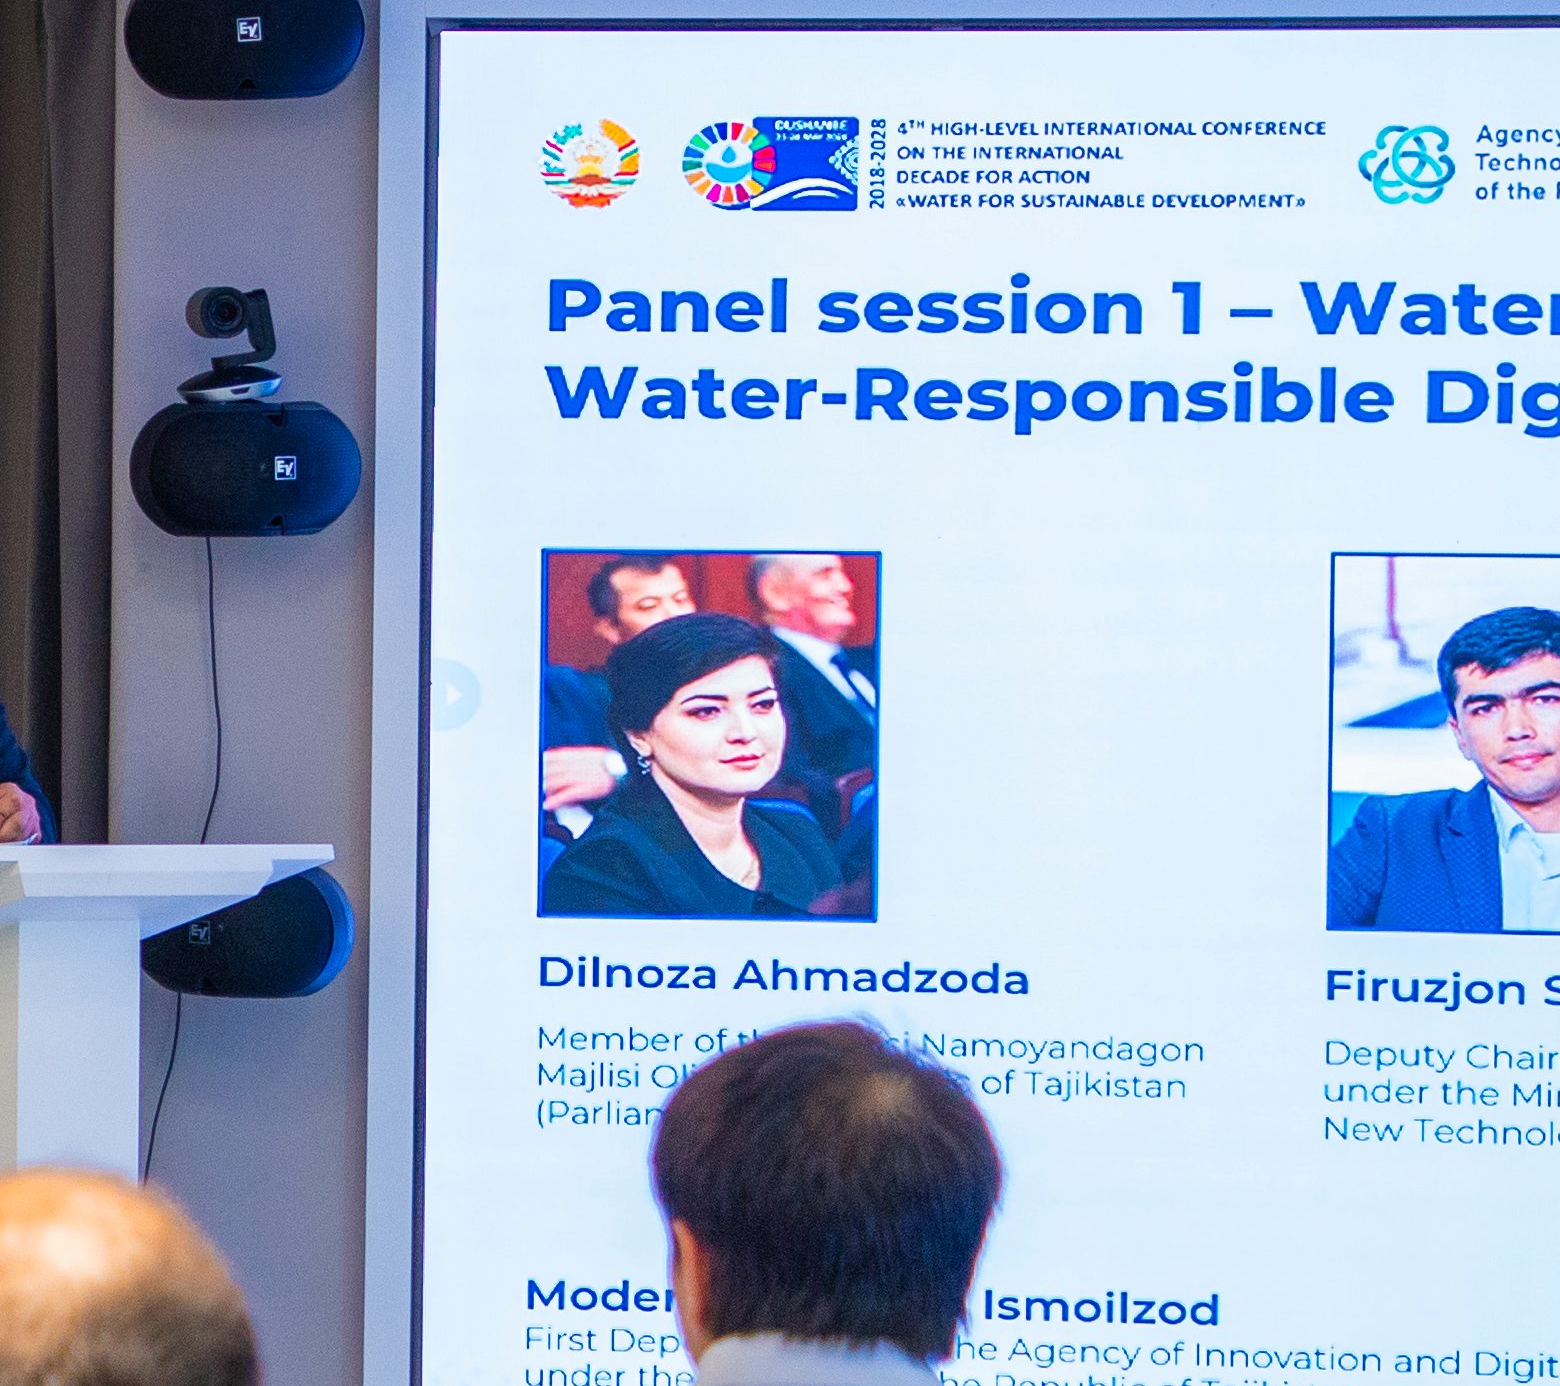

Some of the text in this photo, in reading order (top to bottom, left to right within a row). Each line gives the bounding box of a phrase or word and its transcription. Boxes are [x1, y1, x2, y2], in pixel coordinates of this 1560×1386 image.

[897, 119, 1326, 136] 4TH HIGH-LEVEL INTERNATIONAL CONFERENCE
[870, 118, 886, 208] 2018-2028
[897, 146, 1124, 161] ON THE INTERNATIONAL
[896, 170, 1090, 185] DECADE FOR ACTION
[1475, 181, 1499, 200] of
[1507, 182, 1546, 200] the
[896, 194, 1305, 208] «WATER FOR SUSTAINABLE DEVELOPMENT»
[549, 278, 788, 333] Panel
[818, 272, 1142, 334] session
[1172, 281, 1201, 335] 1
[544, 361, 1394, 435] Water-Responsible
[540, 956, 1029, 994] Dilnoza Ahmadzoda
[1327, 969, 1525, 1012] Firuzjon
[539, 1026, 683, 1052] Member
[695, 1027, 728, 1053] of
[923, 1032, 1205, 1066] Namoyandagon
[1326, 1040, 1455, 1073] Deputy
[538, 1062, 639, 1093] Majlisi
[981, 1069, 1015, 1094] of
[1025, 1071, 1185, 1102] Tajikistan
[1324, 1079, 1429, 1104] under
[1441, 1080, 1499, 1106] the
[1325, 1116, 1404, 1142] New
[527, 1279, 1219, 1326] Moder Ismoilzod
[526, 1326, 596, 1351] First
[611, 1328, 680, 1359] Dep
[956, 1333, 997, 1361] he
[1008, 1338, 1141, 1371] Agency
[1150, 1340, 1185, 1365] of
[1196, 1343, 1381, 1372] Innovation
[1394, 1350, 1460, 1375] and
